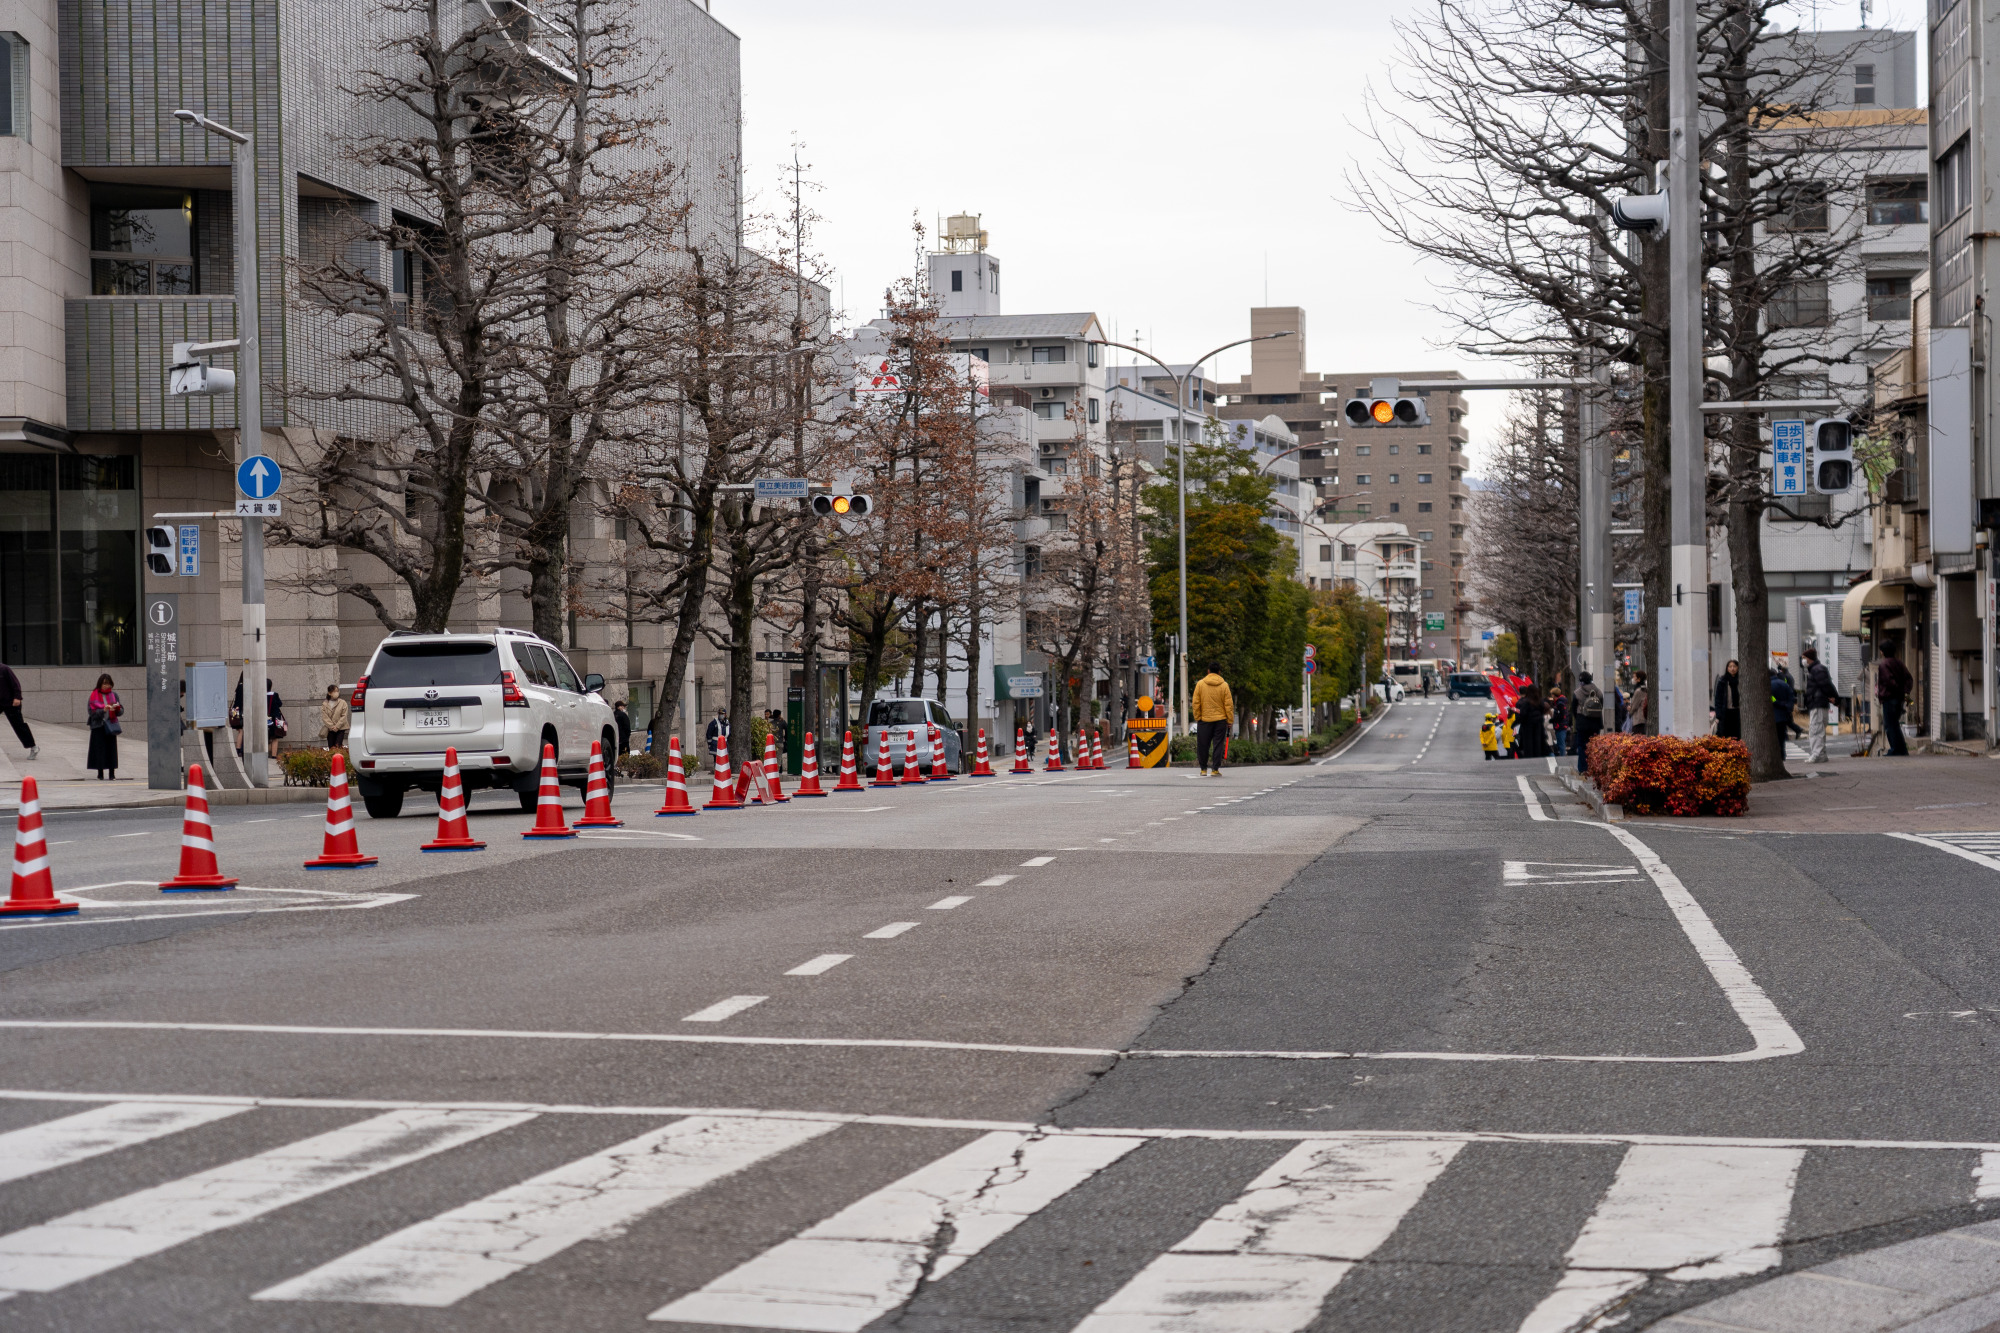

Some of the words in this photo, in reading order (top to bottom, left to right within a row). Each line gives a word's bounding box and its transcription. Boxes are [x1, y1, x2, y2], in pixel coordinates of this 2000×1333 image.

[1777, 425, 1789, 464] 自転車
[1789, 425, 1802, 464] 歩行者
[1783, 465, 1796, 490] 専用
[239, 503, 278, 513] 大貨等
[186, 556, 193, 573] 専用
[167, 632, 176, 661] 城下筋
[423, 716, 448, 726] 64-55
